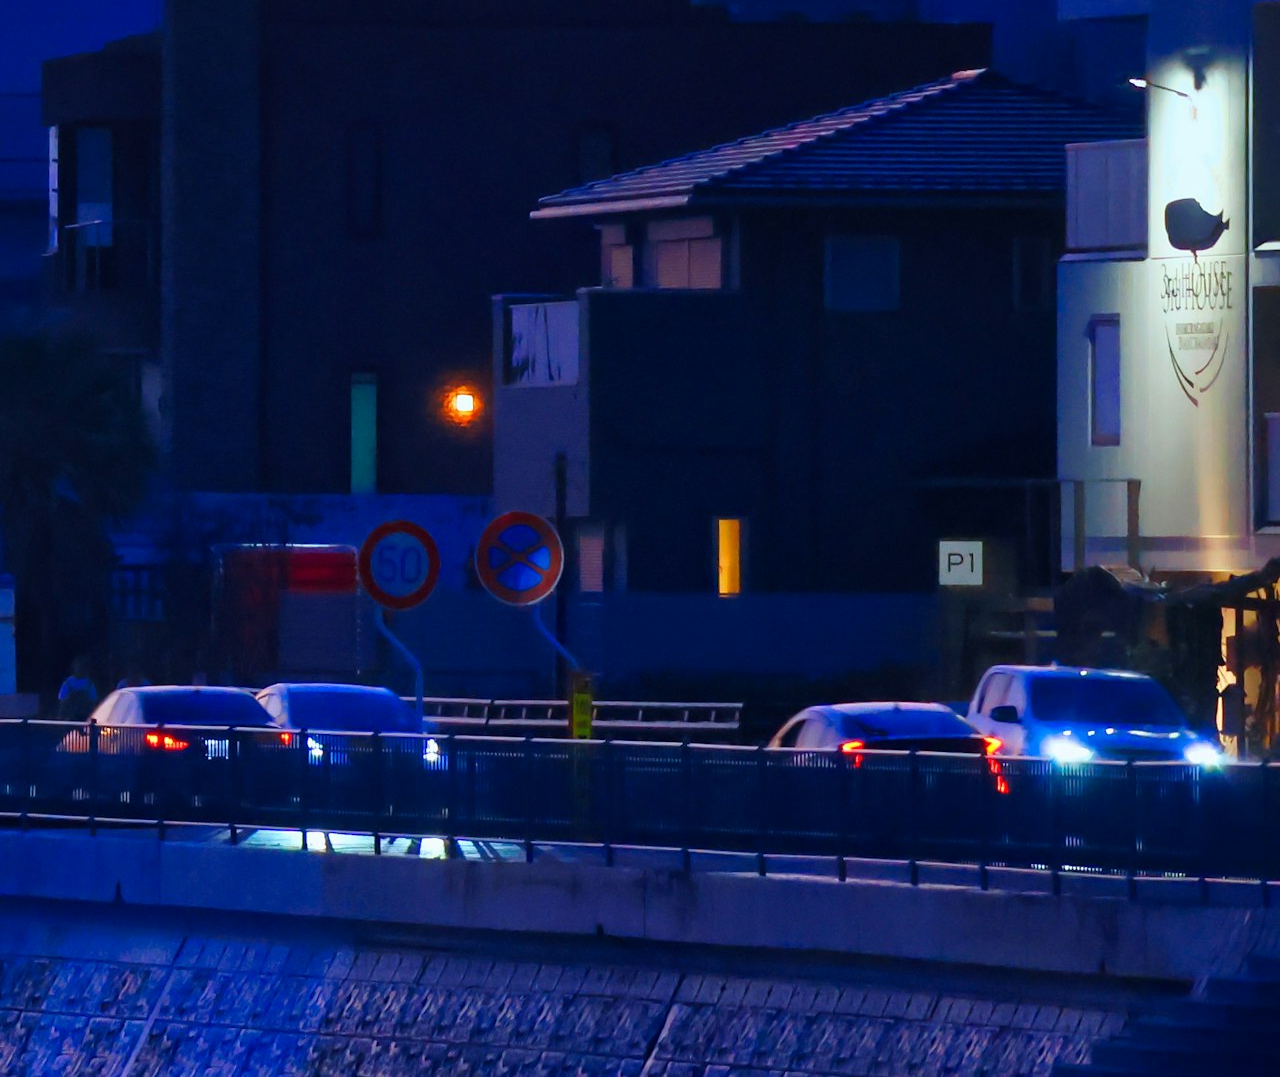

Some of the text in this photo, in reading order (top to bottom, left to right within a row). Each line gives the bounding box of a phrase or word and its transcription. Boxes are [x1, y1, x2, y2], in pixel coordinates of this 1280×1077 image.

[1182, 261, 1228, 303] HOUSE
[377, 545, 422, 584] 50
[948, 553, 974, 573] P1
